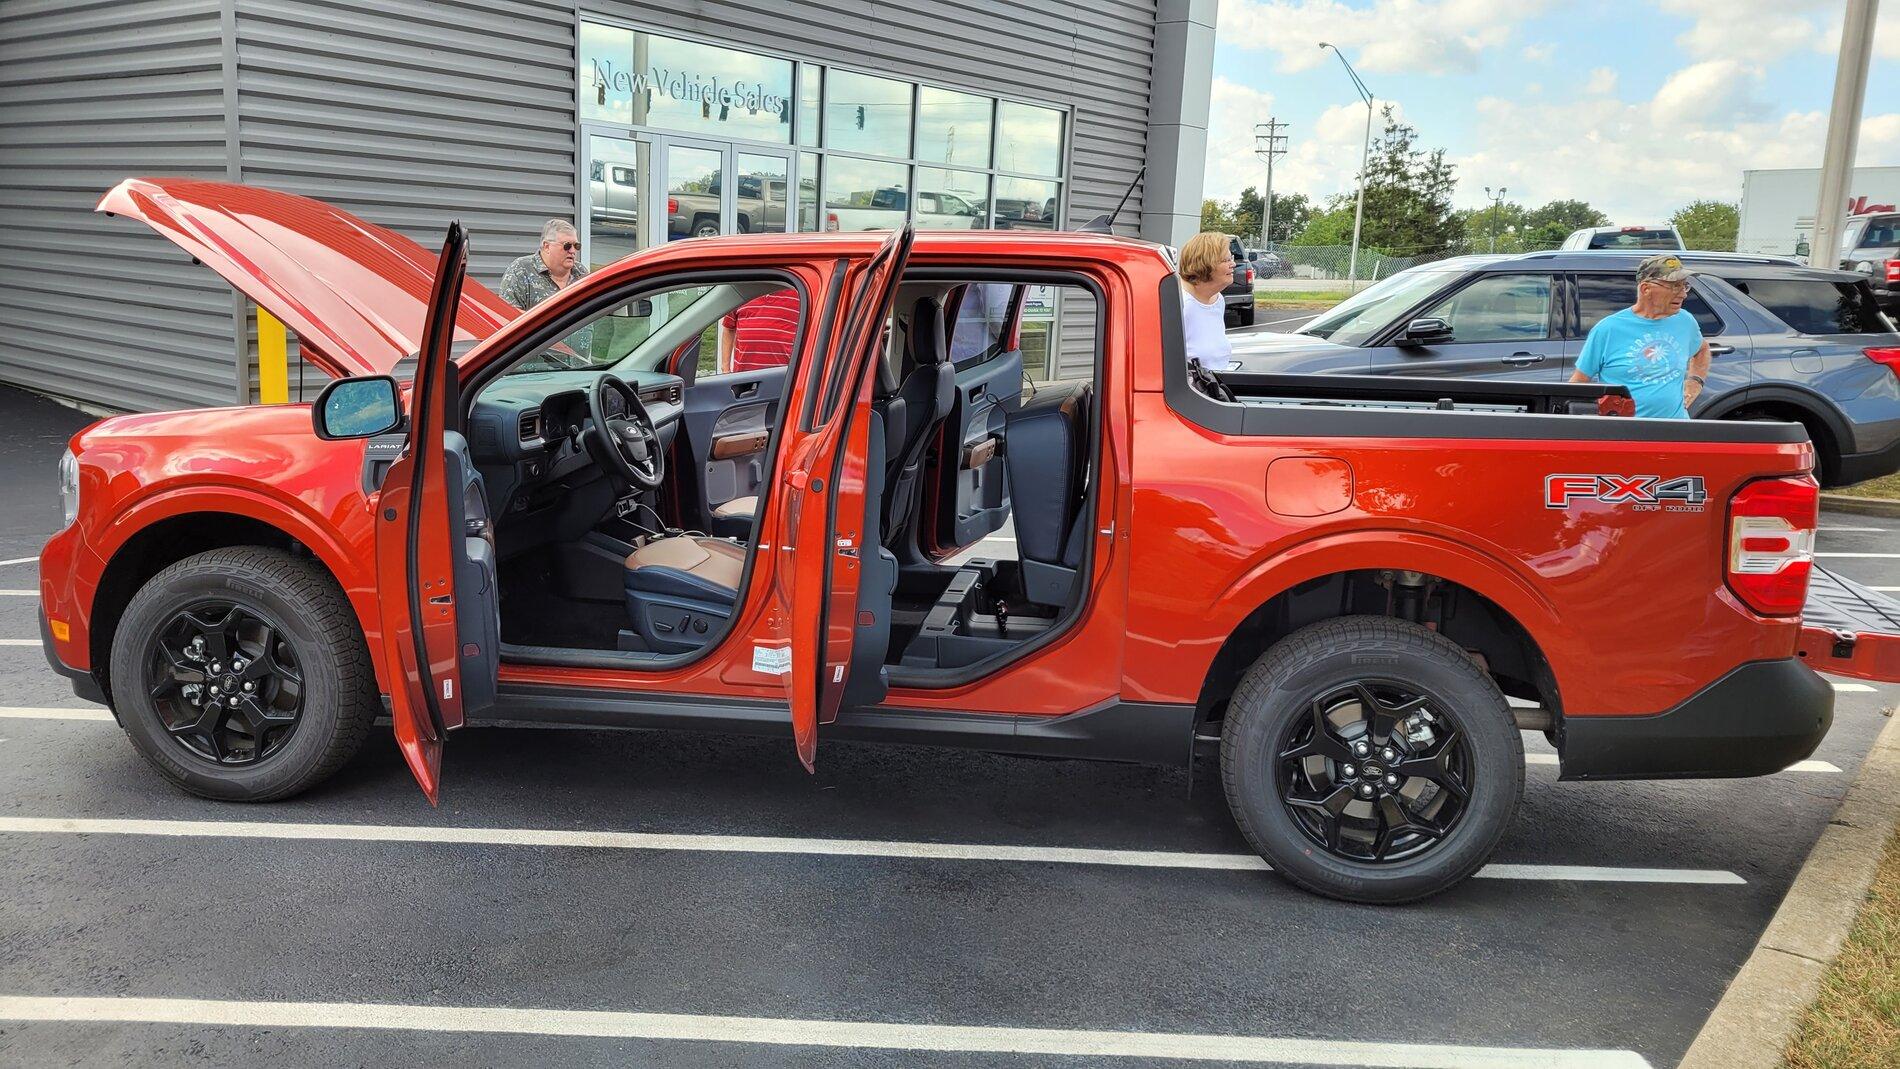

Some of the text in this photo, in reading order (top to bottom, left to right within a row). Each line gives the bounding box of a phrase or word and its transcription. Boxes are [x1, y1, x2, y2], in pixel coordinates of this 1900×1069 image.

[592, 57, 785, 115] New Vehicle Sales
[1545, 474, 1708, 509] FX4
